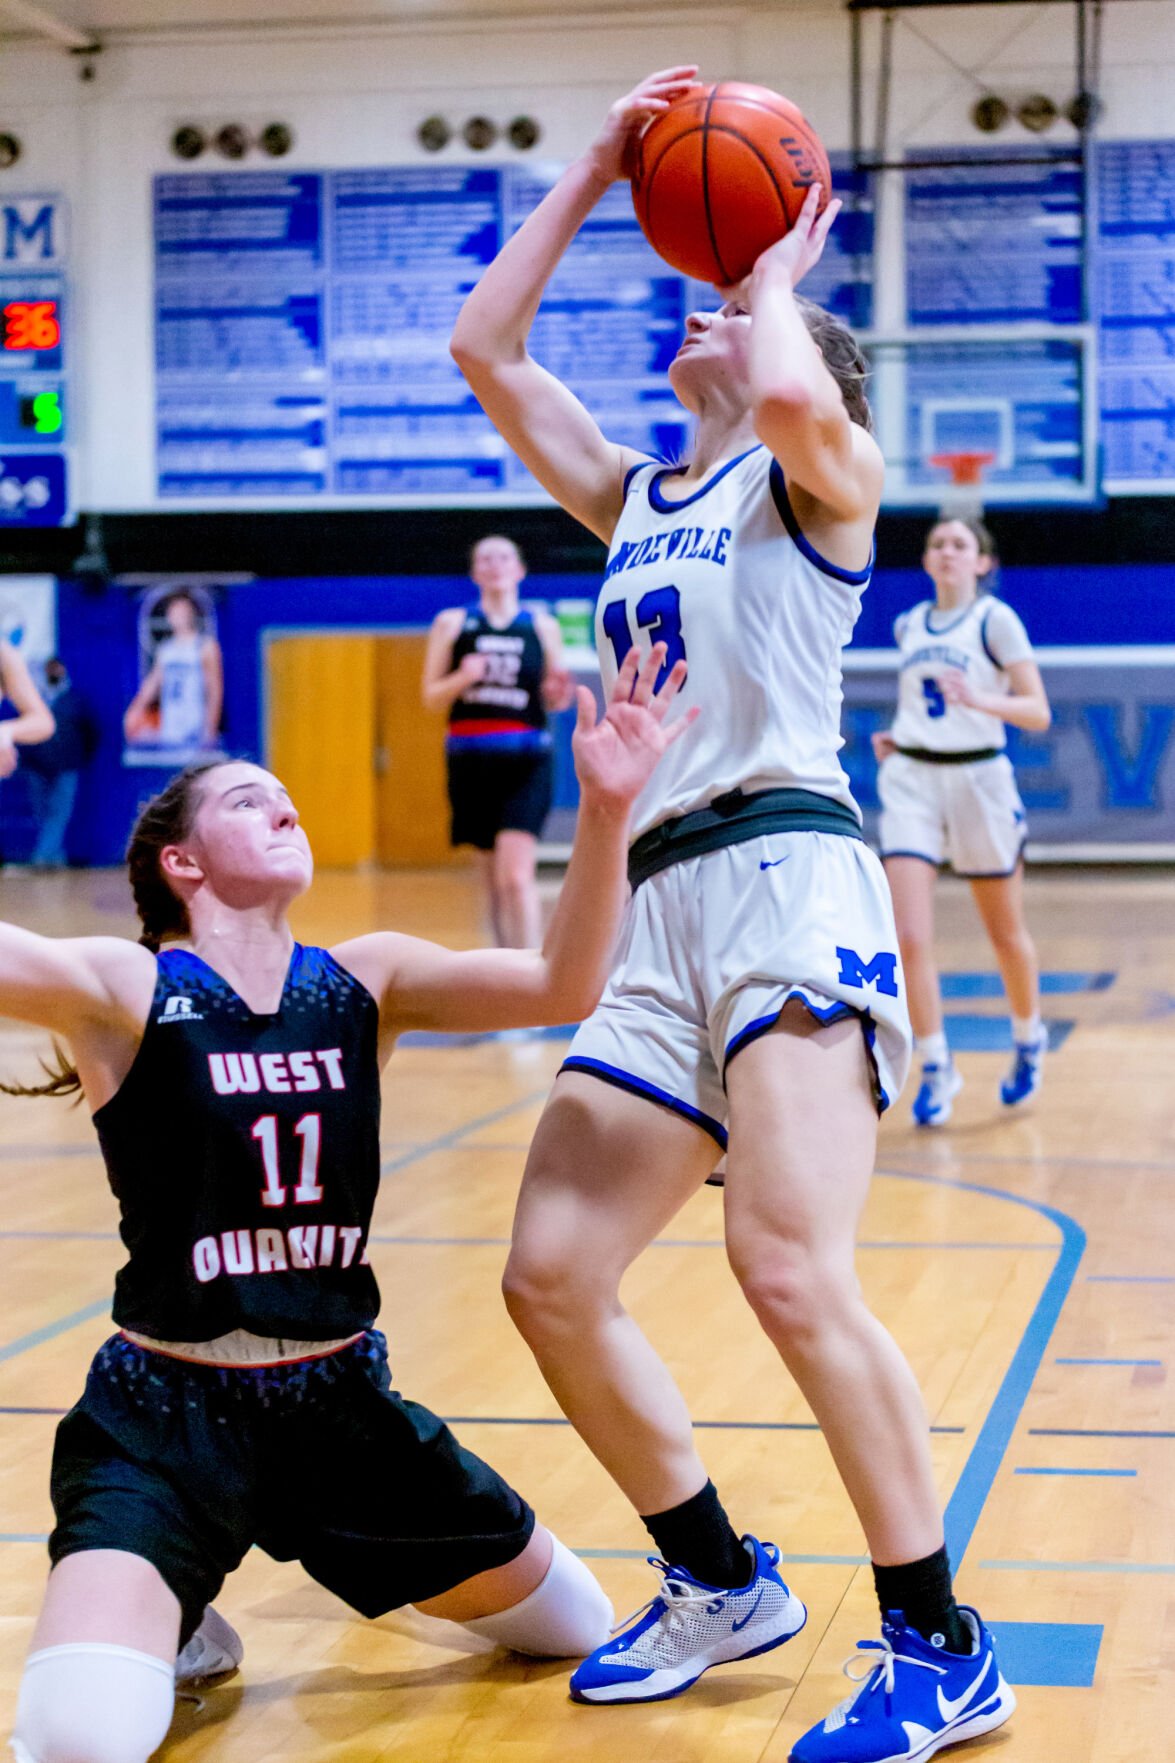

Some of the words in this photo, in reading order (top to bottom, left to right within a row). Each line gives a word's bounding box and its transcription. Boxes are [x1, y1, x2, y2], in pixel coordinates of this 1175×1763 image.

[3, 205, 54, 260] M
[4, 301, 60, 350] 36
[603, 585, 687, 702] 13
[836, 946, 898, 997] M
[208, 1048, 346, 1095] WEST
[251, 1112, 324, 1207] 11
